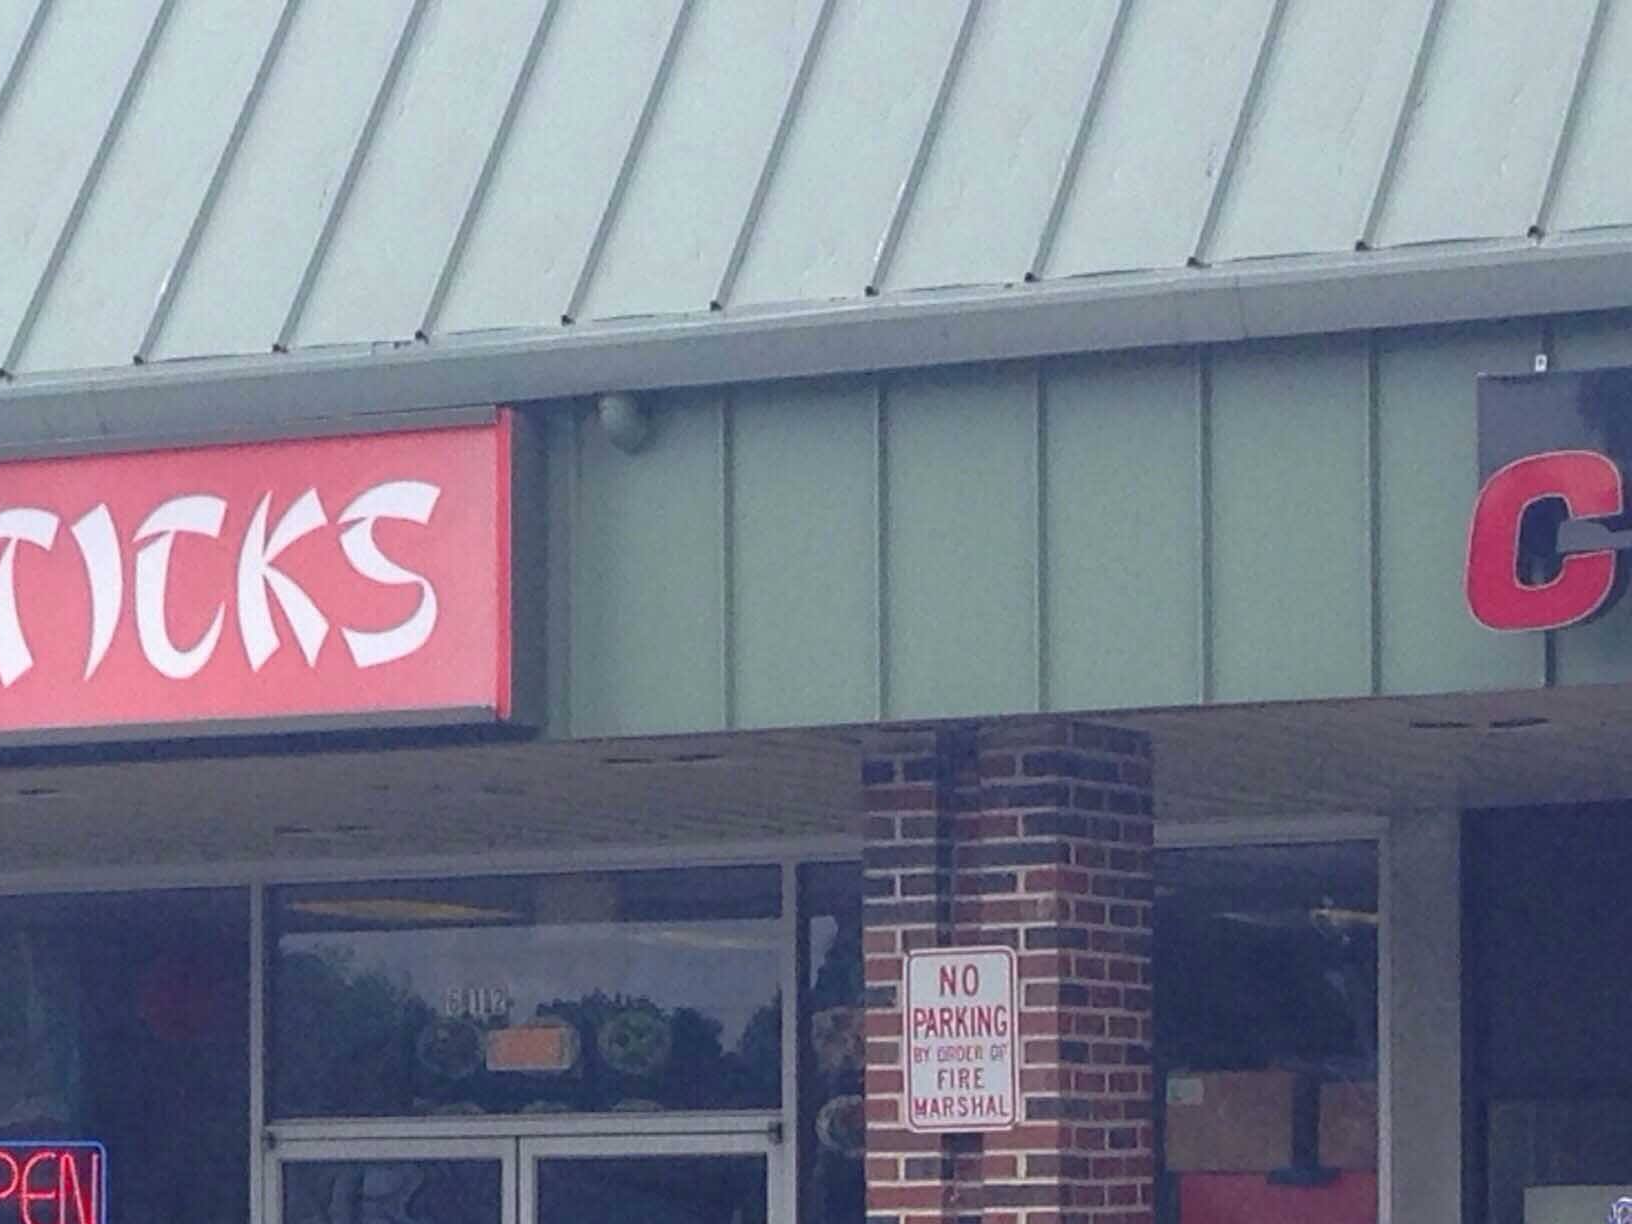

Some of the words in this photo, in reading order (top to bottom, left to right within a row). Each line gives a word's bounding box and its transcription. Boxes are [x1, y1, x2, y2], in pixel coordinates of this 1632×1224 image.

[939, 964, 979, 997] NO
[913, 1005, 1008, 1040] PARKING
[913, 1047, 929, 1064] BY
[937, 1045, 983, 1063] ORDER
[991, 1043, 1007, 1062] OF
[937, 1068, 985, 1091] FIRE
[914, 1095, 1010, 1118] MARSHAL
